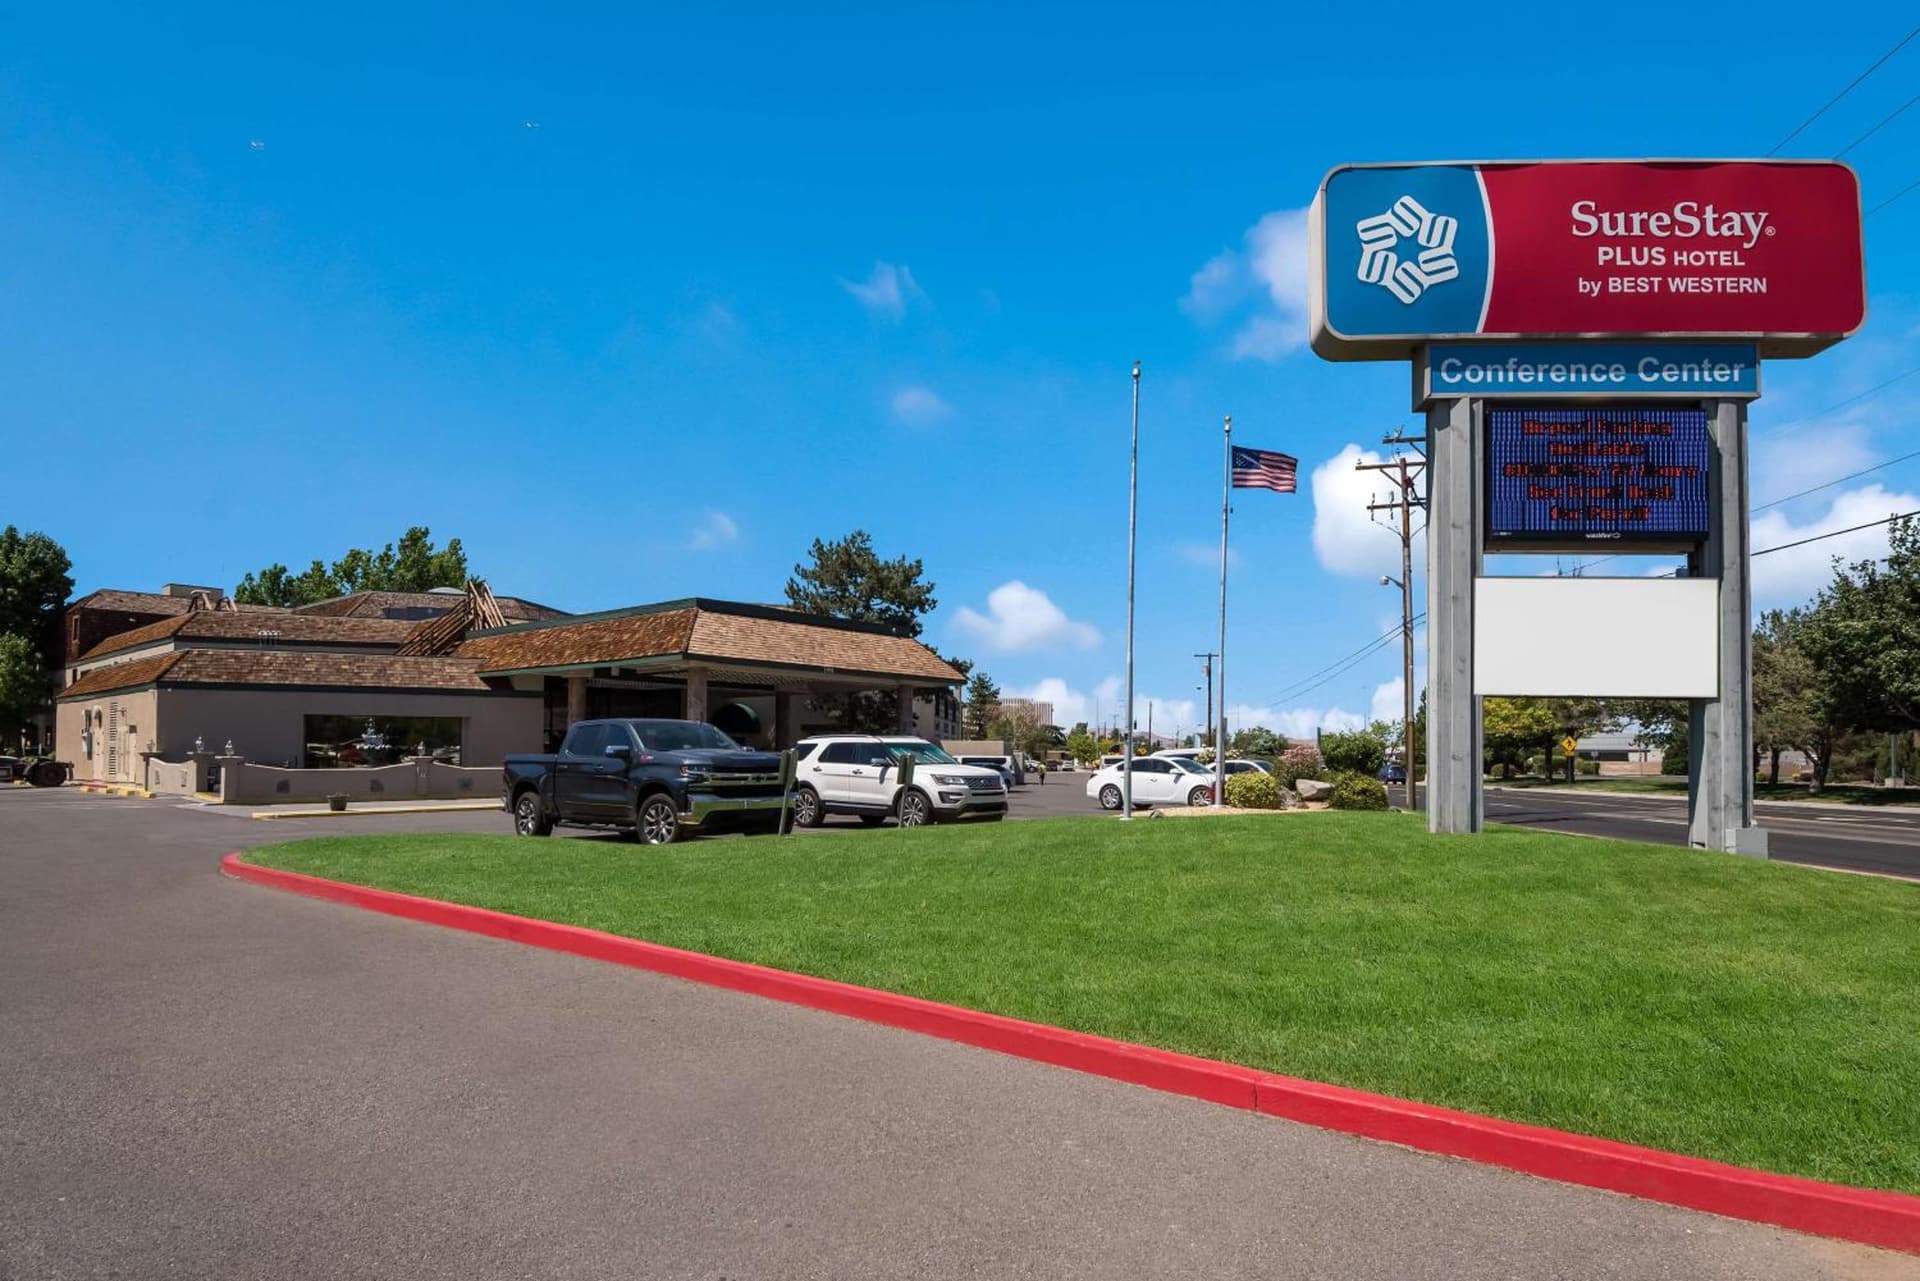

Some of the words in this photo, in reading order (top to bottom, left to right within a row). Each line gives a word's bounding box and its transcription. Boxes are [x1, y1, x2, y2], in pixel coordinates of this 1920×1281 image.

[1598, 247, 1666, 266] PLUS
[1673, 251, 1745, 266] HOTEL
[1578, 277, 1602, 297] by
[1608, 277, 1661, 293] BEST
[1668, 277, 1767, 293] WESTERN
[1440, 357, 1626, 383] Conference
[1637, 356, 1745, 383] Center
